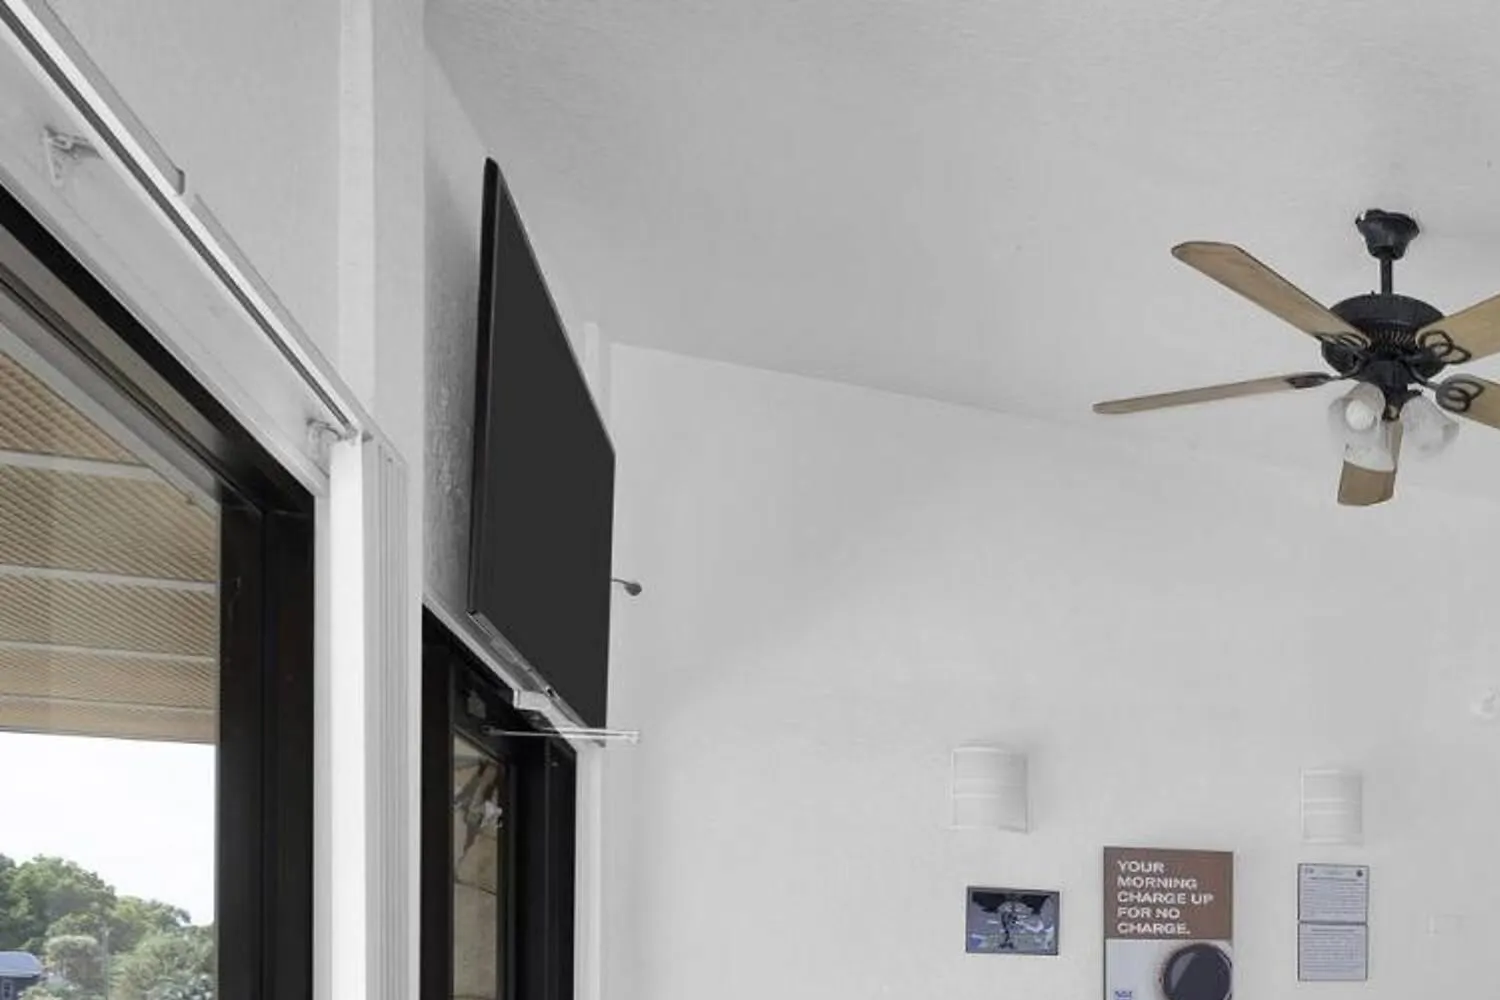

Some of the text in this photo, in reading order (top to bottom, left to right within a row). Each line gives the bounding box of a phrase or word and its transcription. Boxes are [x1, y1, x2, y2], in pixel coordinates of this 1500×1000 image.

[1117, 860, 1165, 873] YOUR
[1117, 876, 1198, 889] MORNING
[1117, 890, 1214, 905] CHARGE UP
[1117, 907, 1180, 919] FOR NO
[1117, 922, 1191, 935] CHARGE.
